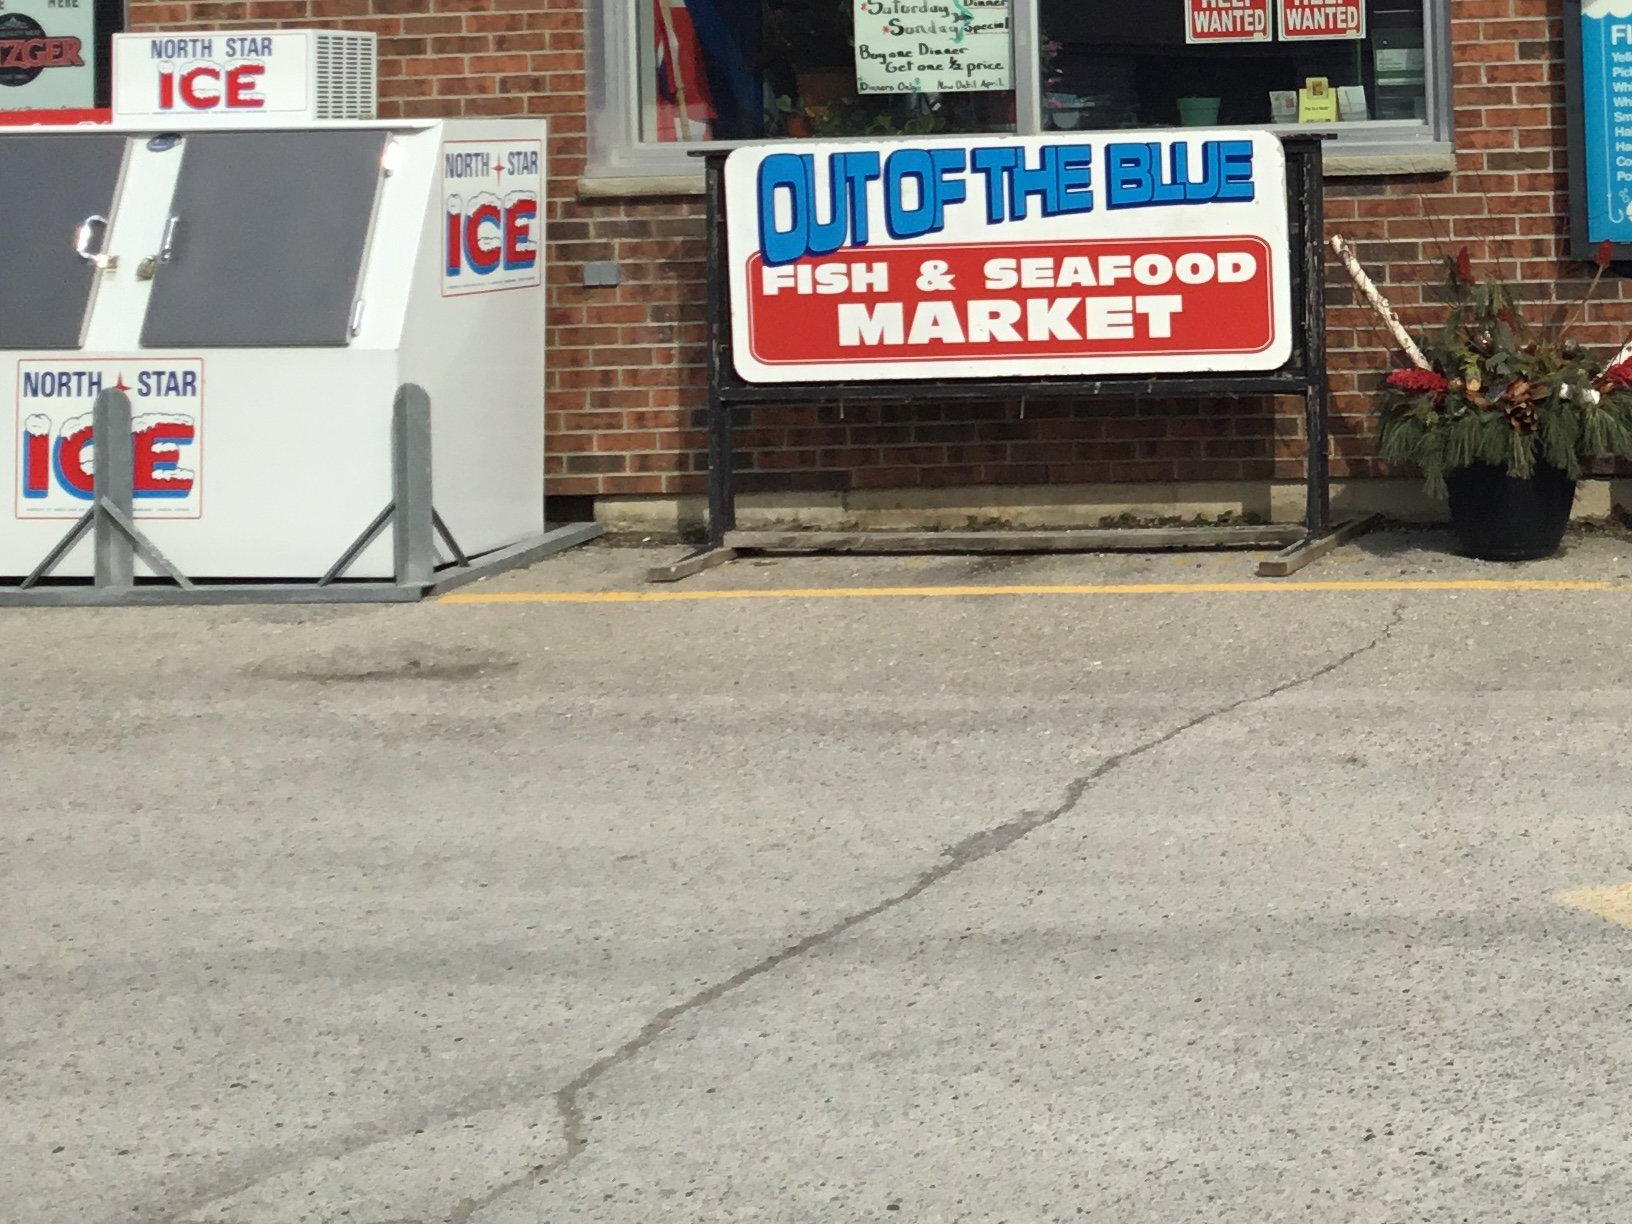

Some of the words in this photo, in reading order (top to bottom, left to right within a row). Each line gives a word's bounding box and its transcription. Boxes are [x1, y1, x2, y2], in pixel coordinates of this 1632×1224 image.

[1193, 10, 1265, 33] WANTED
[1286, 6, 1358, 30] WANTED
[151, 38, 212, 59] NORTH
[226, 37, 273, 57] STAR
[859, 44, 886, 65] Buy
[888, 50, 913, 58] one
[918, 42, 968, 57] Dinner
[885, 61, 913, 73] Get
[967, 62, 1004, 77] price
[157, 60, 266, 111] ICE
[445, 152, 491, 179] NORTH
[507, 151, 538, 175] STAR
[759, 150, 881, 266] OUT
[884, 148, 967, 239] OF
[971, 143, 1093, 224] THE
[1105, 140, 1255, 210] BLUE
[446, 190, 537, 277] ICE
[761, 262, 889, 296] FISH
[915, 260, 957, 292] &
[984, 252, 1257, 291] SEAFOOD
[838, 294, 1183, 347] MARKET
[23, 371, 102, 398] NORTH
[137, 370, 197, 397] STAR
